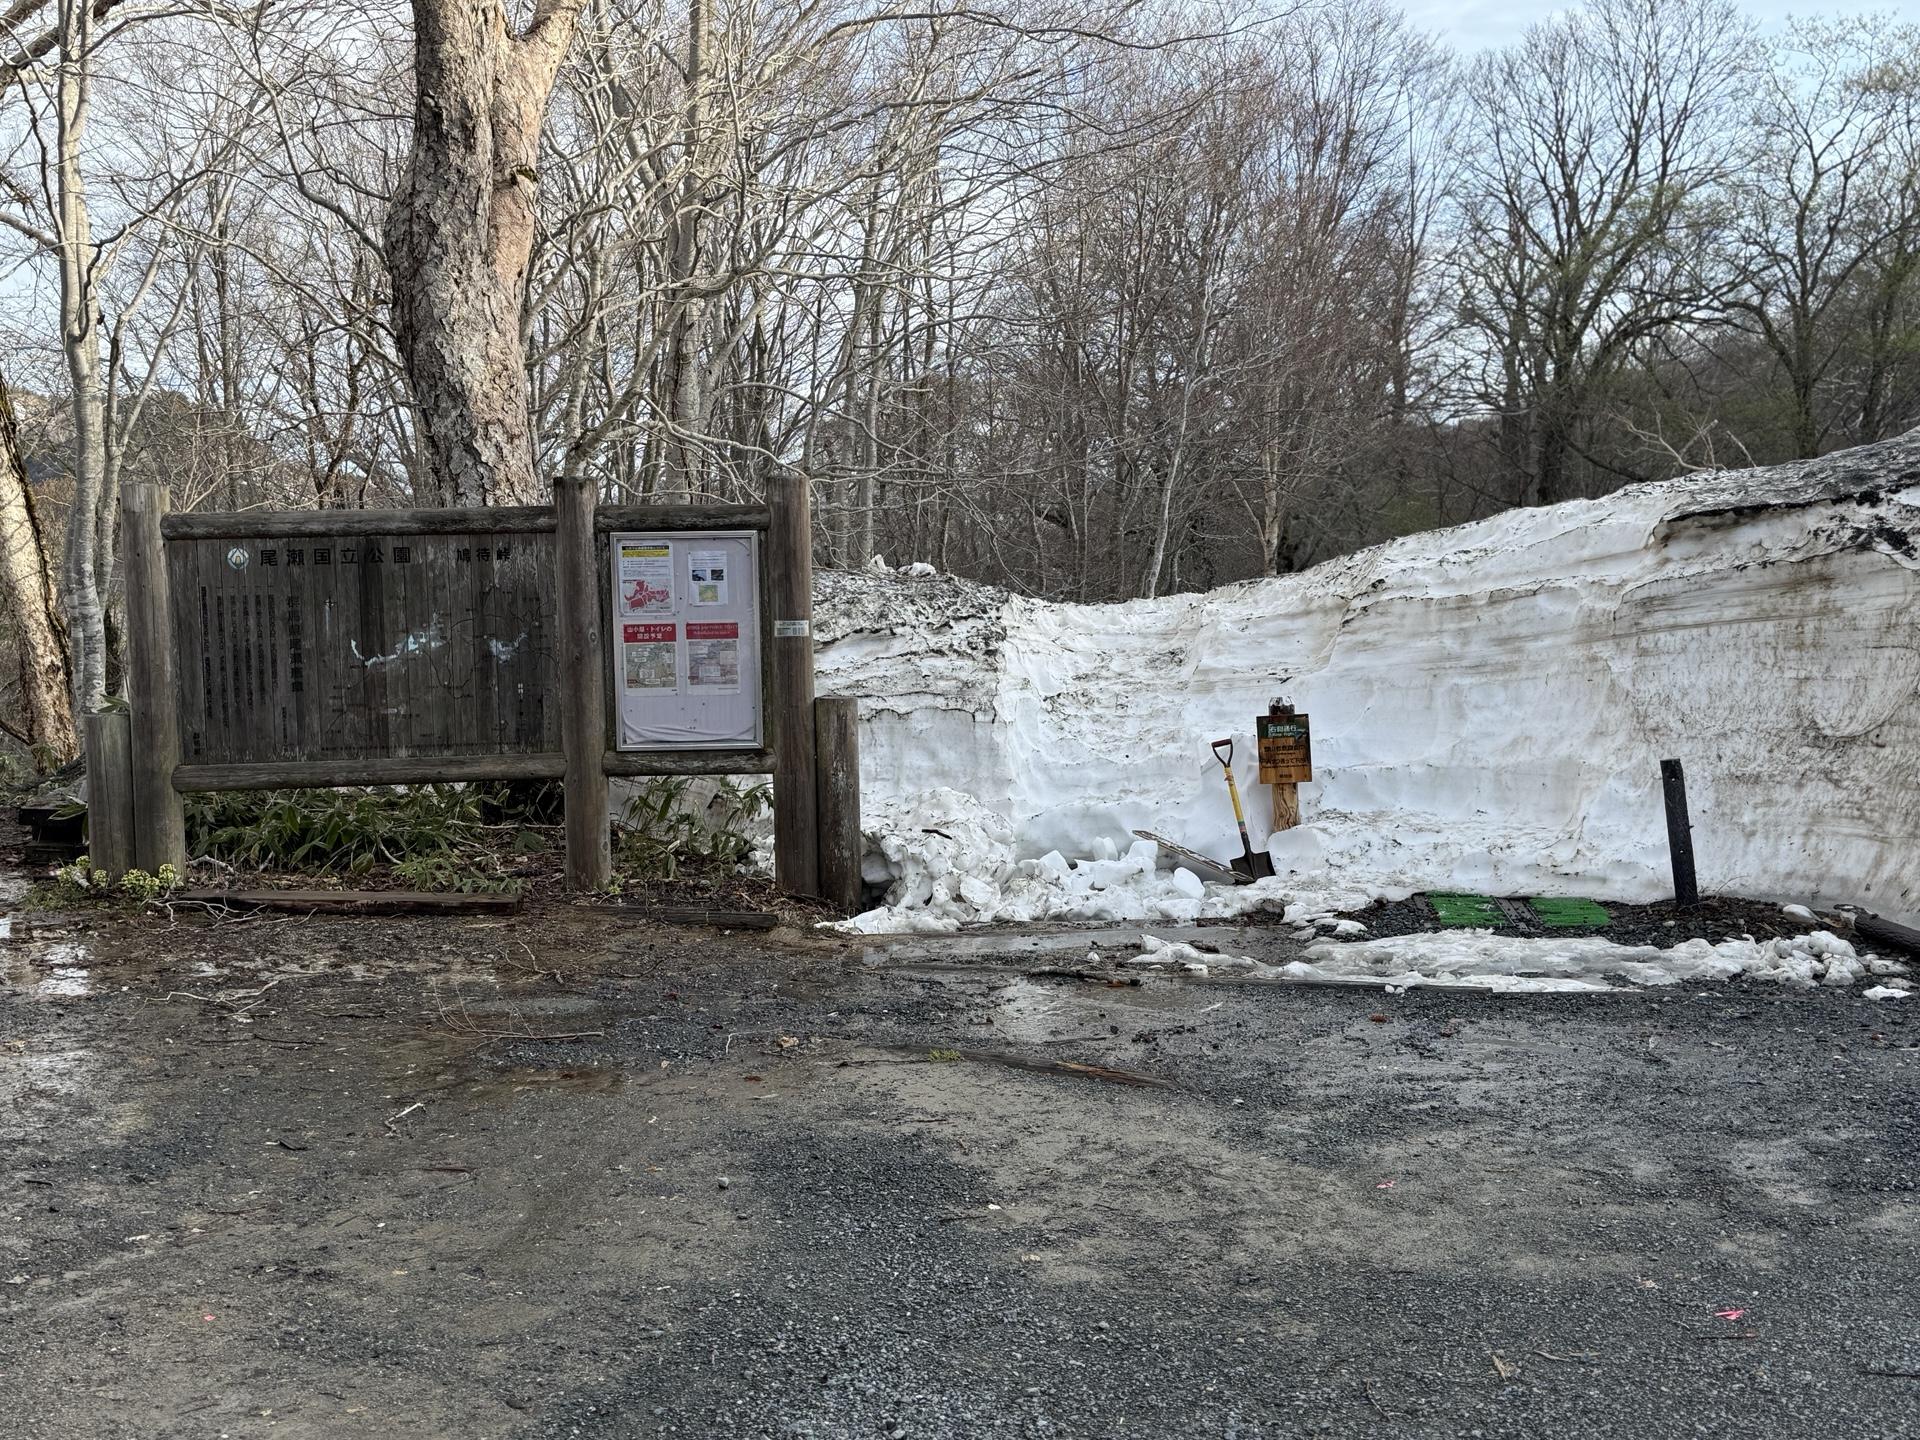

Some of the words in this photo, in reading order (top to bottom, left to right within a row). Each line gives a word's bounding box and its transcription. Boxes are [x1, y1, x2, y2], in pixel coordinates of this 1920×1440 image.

[260, 546, 411, 567] 尾瀬国立公園
